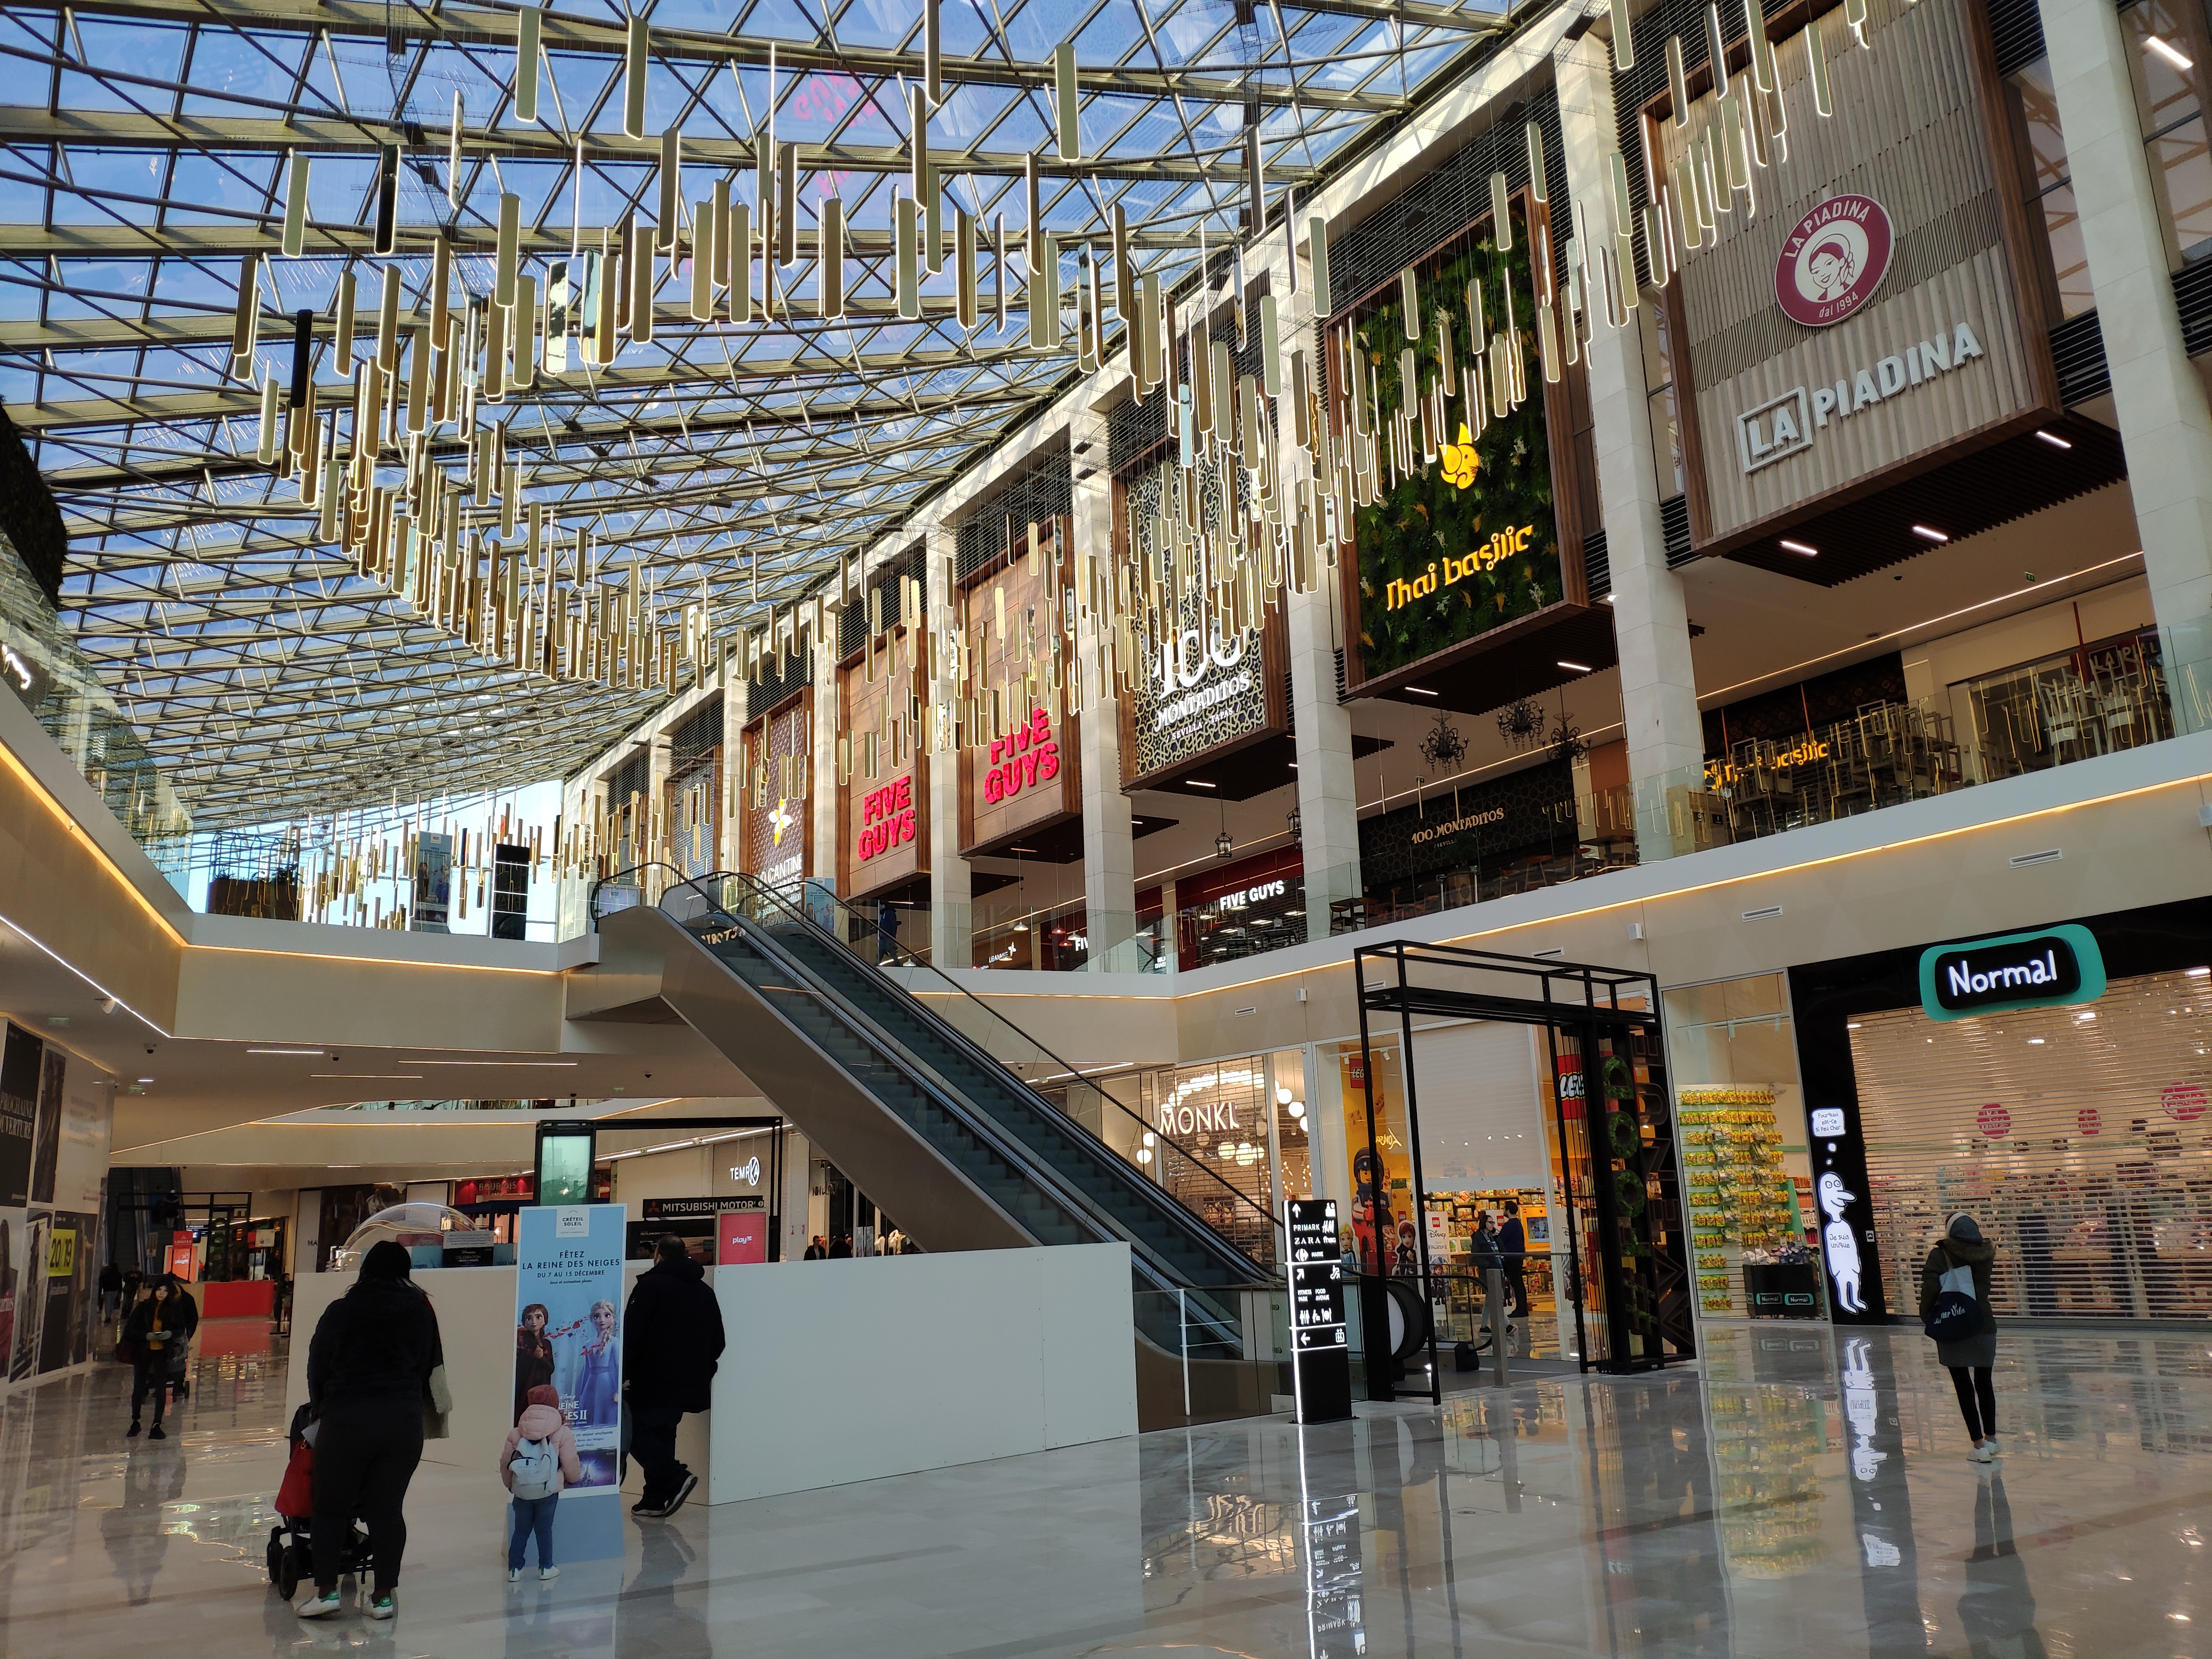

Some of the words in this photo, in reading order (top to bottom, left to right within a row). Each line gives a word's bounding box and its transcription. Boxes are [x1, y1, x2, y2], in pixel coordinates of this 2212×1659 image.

[1784, 236, 1805, 258] LA
[1803, 200, 1870, 234] PIADINA
[1819, 306, 1833, 318] dal
[1836, 291, 1859, 313] 1994
[1748, 407, 1799, 456] LA
[1813, 321, 1985, 427] PIADINA
[1386, 562, 1437, 611] Thai
[1154, 671, 1250, 732] MONTADITOS
[990, 708, 1051, 764] FIVE
[1172, 722, 1203, 740] SEVILLA
[1210, 707, 1233, 724] TAPAS
[985, 742, 1059, 804] GUYS
[864, 775, 911, 825] FIVE
[857, 809, 916, 861] GUYS
[1411, 829, 1433, 844] 100
[1434, 808, 1504, 838] MONTADITOS
[768, 853, 802, 884] CANTINE
[1220, 890, 1246, 910] FIVE
[1249, 880, 1284, 902] GUYS
[1075, 937, 1088, 951] FIV
[1949, 949, 2057, 996] Normal
[1351, 1068, 1365, 1080] LEG
[0, 1092, 34, 1119] PROCHAINE
[662, 1201, 718, 1212] MITSUBISHI
[1293, 1223, 1320, 1232] PRIMARK
[1294, 1237, 1321, 1245] ZARA
[1426, 1229, 1447, 1240] Disney
[560, 1250, 585, 1259] FÊTEZ
